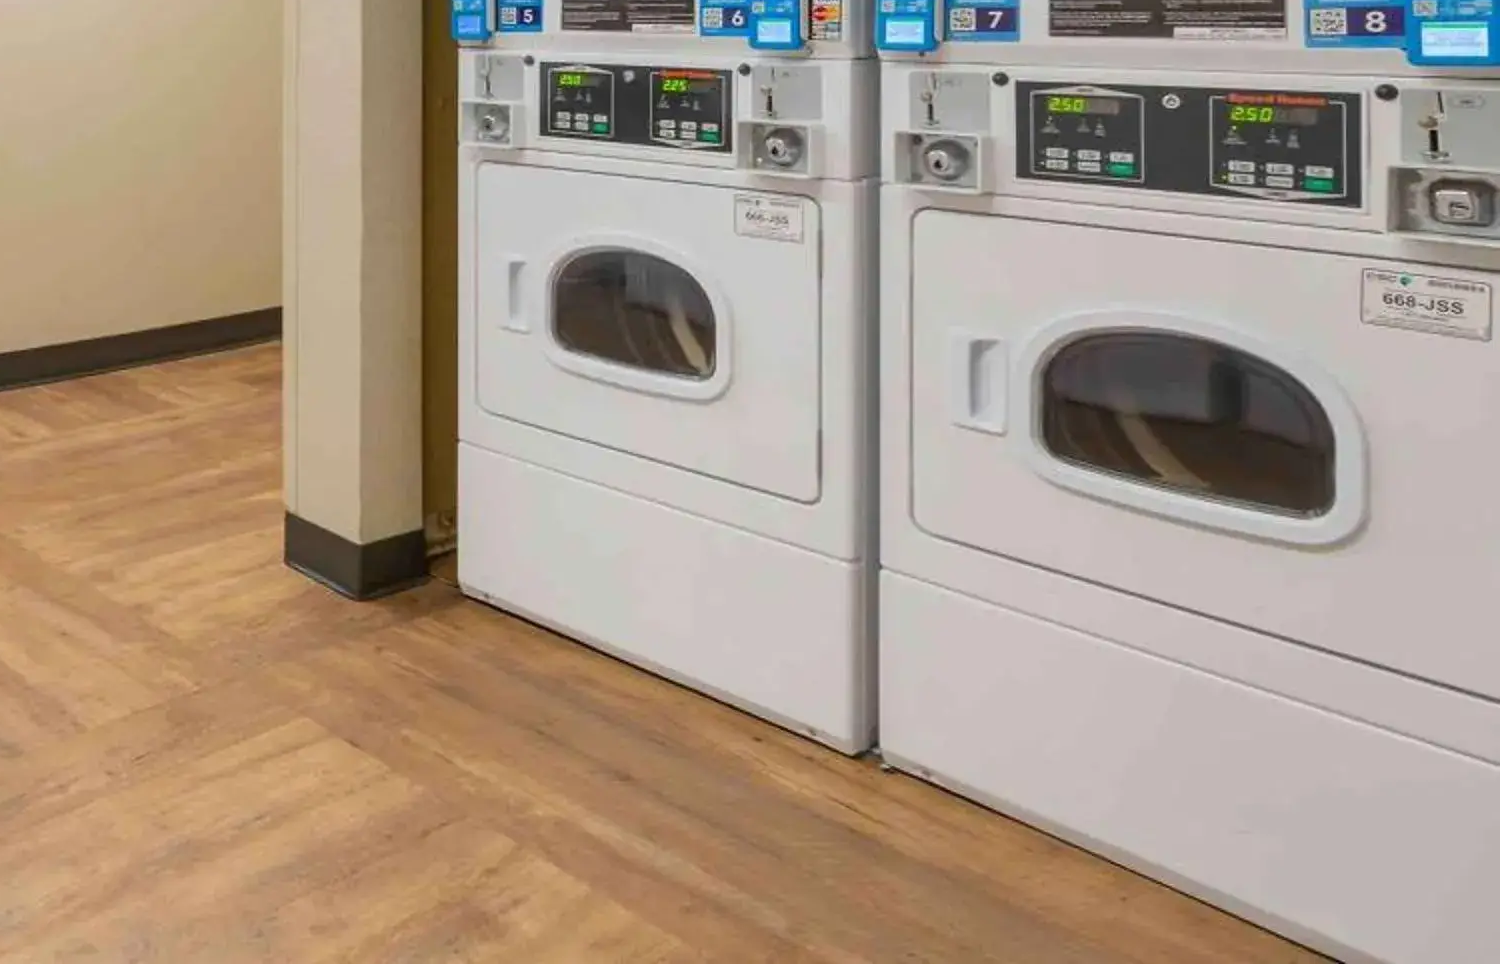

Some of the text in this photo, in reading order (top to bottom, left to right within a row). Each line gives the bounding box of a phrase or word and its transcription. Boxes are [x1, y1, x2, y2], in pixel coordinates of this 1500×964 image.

[523, 8, 534, 24] 5
[731, 9, 745, 27] 6
[987, 10, 1004, 29] 7
[1364, 10, 1388, 33] 8
[1381, 293, 1466, 315] 668-JSS
